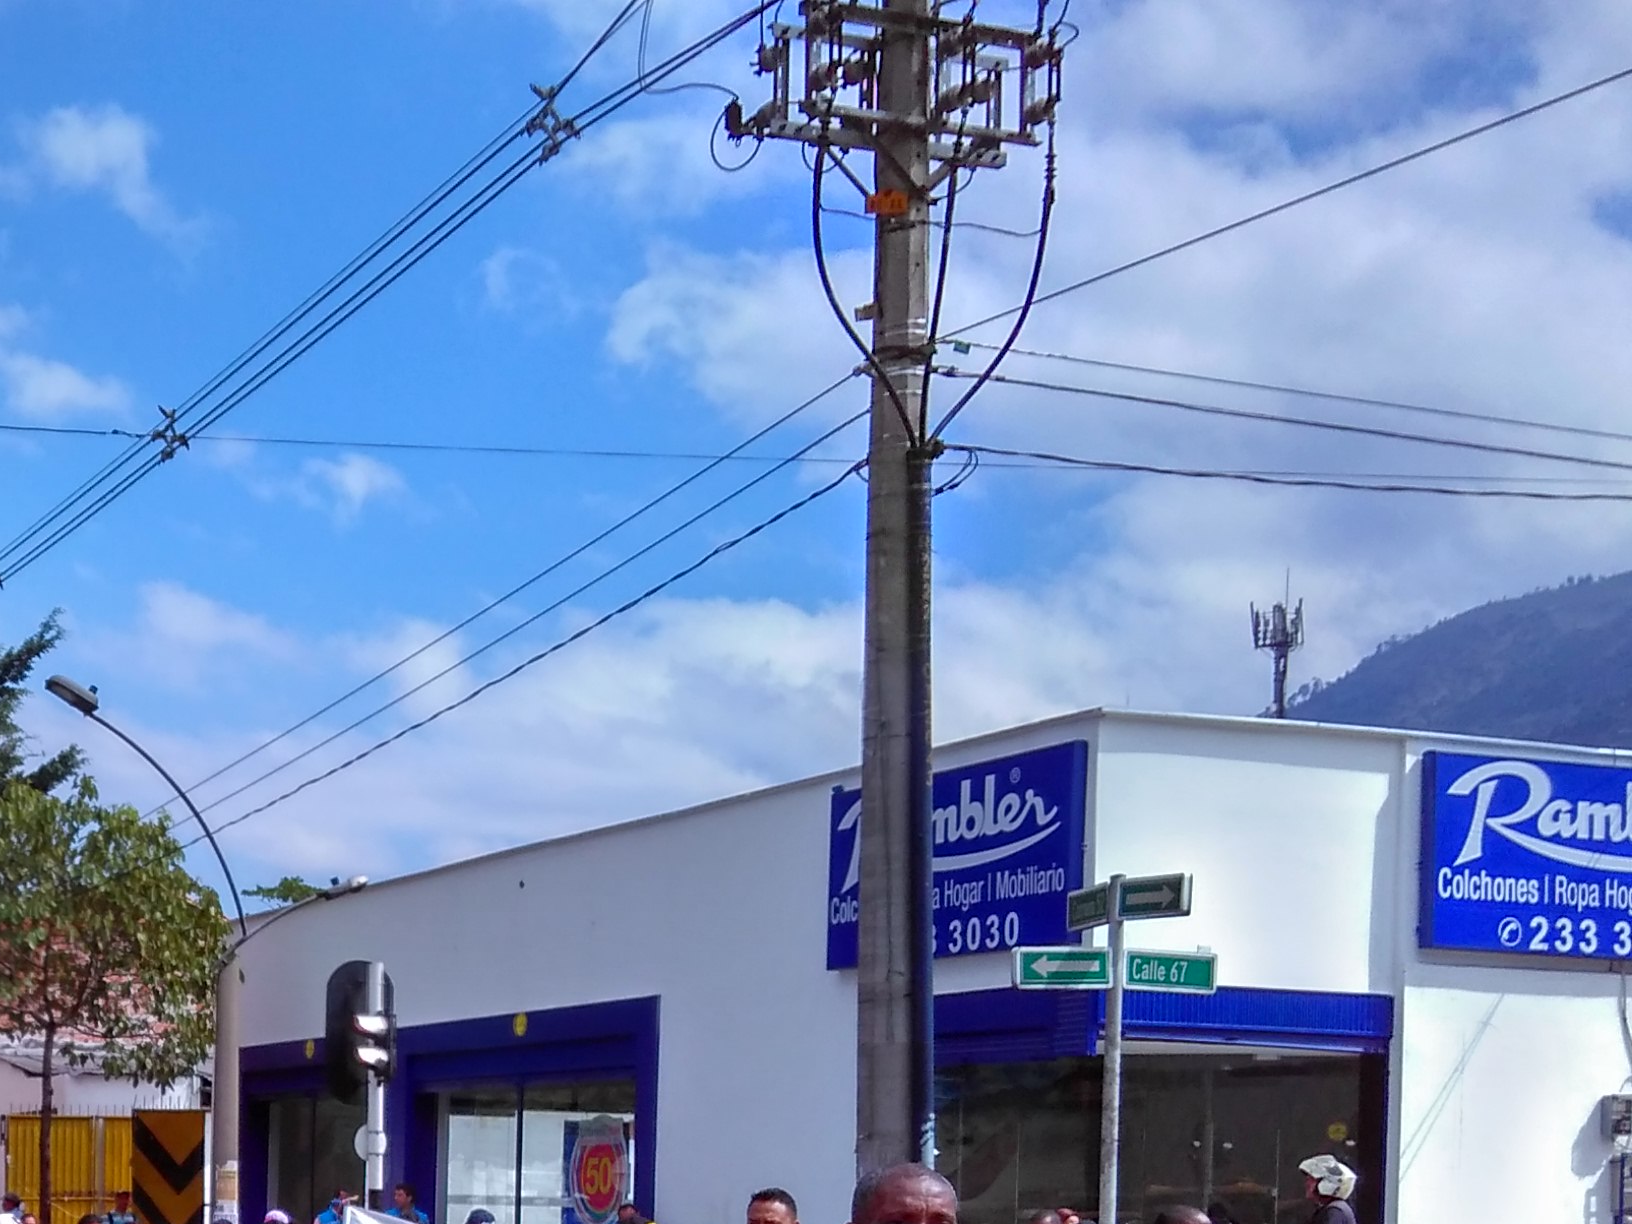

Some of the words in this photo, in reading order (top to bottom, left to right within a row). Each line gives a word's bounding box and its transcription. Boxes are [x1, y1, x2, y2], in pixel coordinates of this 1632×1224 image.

[1446, 760, 1632, 873] Ram
[831, 897, 858, 925] Colc
[944, 879, 985, 912] Hogar
[996, 862, 1066, 901] Mobiliario
[1438, 866, 1539, 904] Colchones
[1555, 875, 1600, 912] Ropa
[948, 912, 1019, 954] 3030
[1528, 915, 1598, 955] 233
[1132, 958, 1166, 981] Calle
[1170, 961, 1188, 983] 67
[585, 1157, 612, 1195] 50
